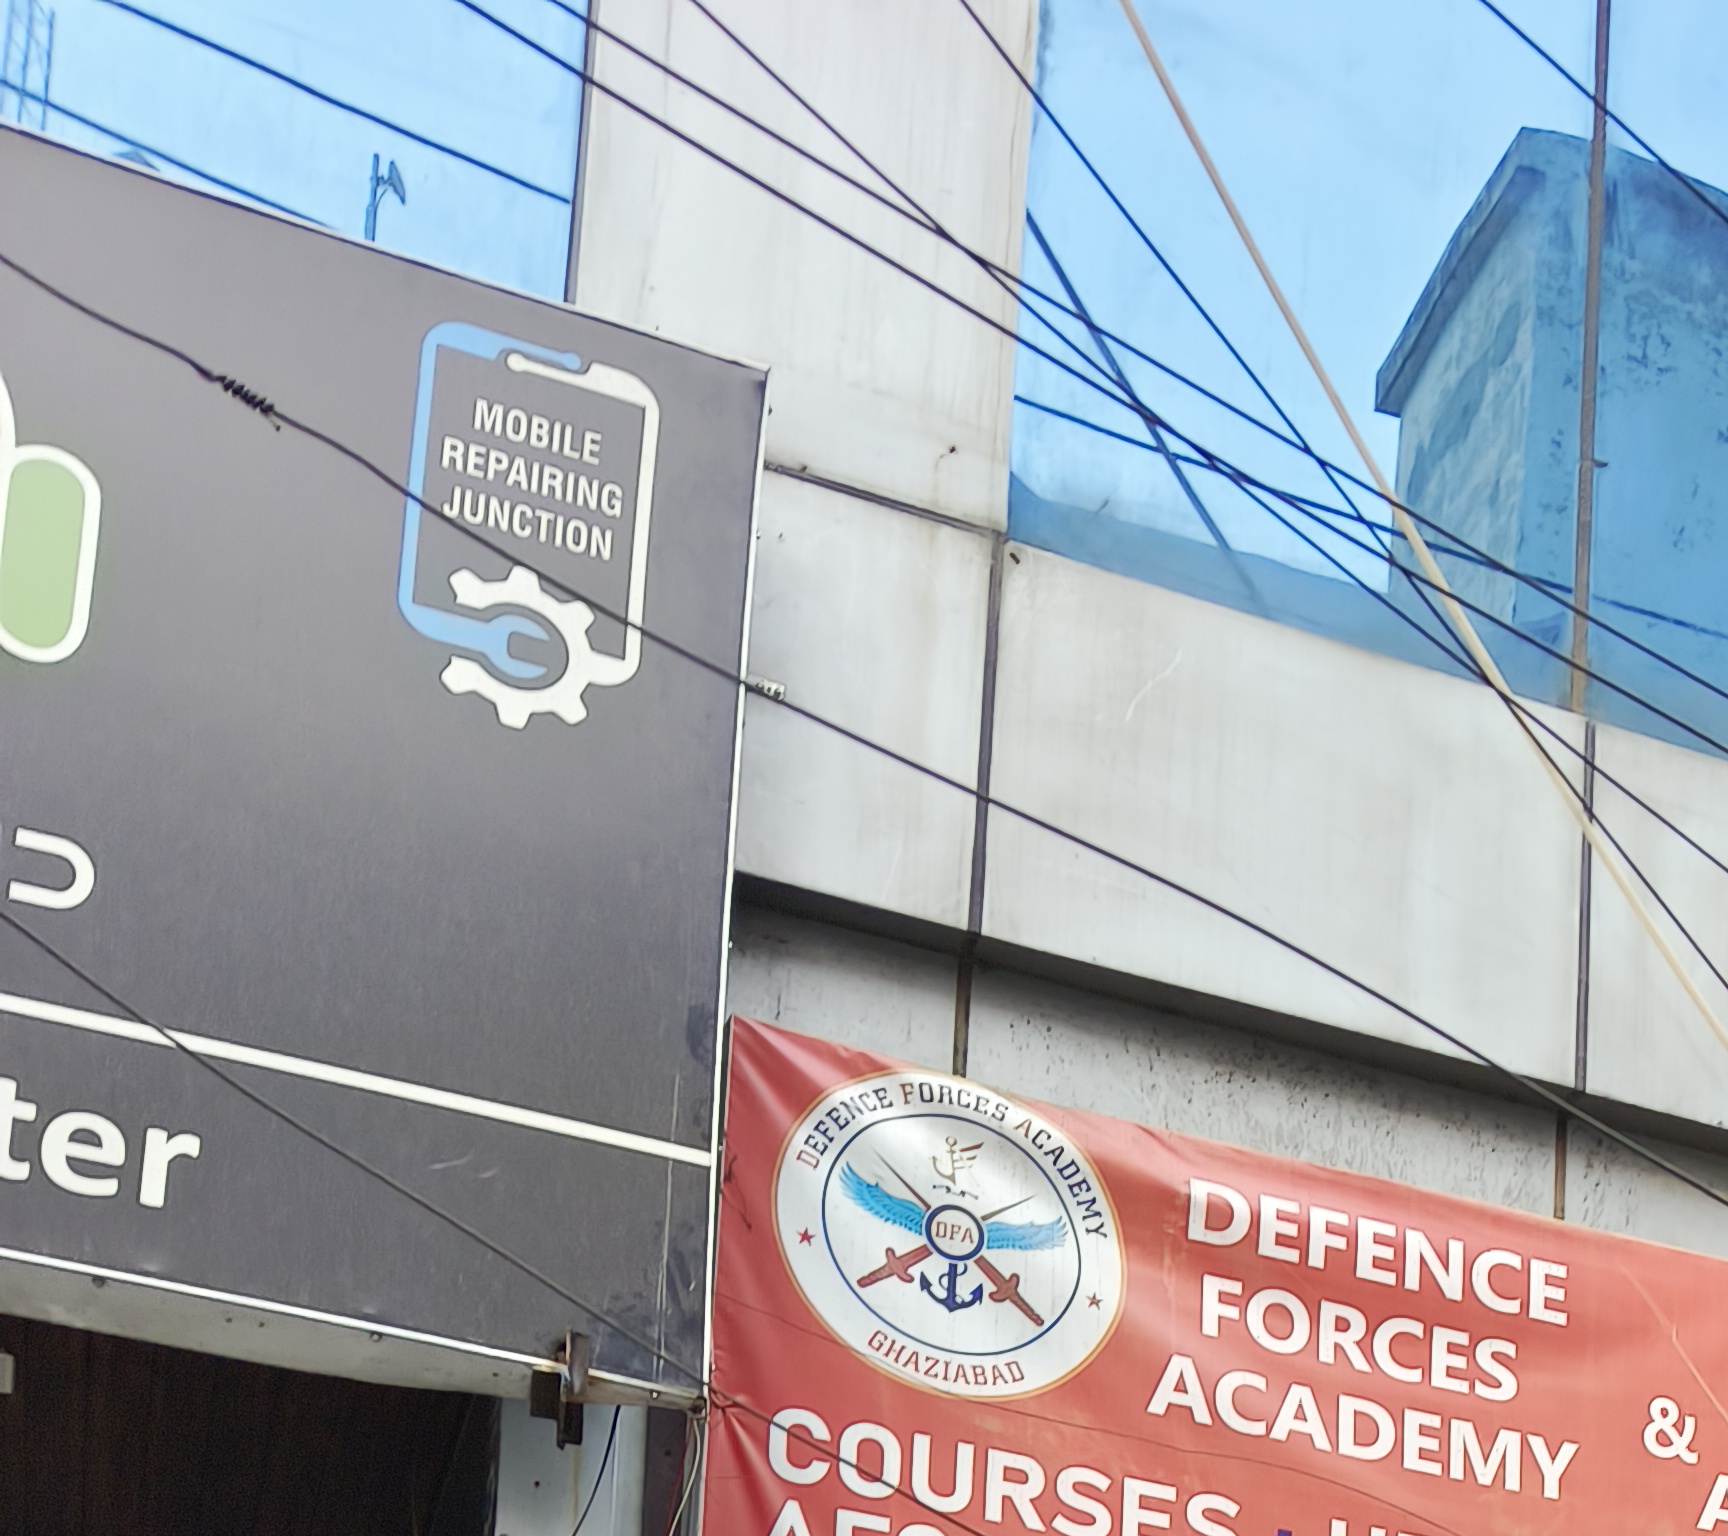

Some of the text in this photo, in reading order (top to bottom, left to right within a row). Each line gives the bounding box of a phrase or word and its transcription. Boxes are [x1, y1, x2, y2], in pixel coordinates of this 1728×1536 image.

[473, 398, 602, 465] MOBILE
[441, 435, 623, 518] REPAIRING
[442, 486, 613, 560] JUNCTION
[796, 1082, 1108, 1239] DEFENCE FORCES ACADEMY
[1187, 1177, 1568, 1326] DEFENCE
[867, 1329, 1025, 1386] GHAZIABAD
[1201, 1274, 1519, 1402] FORCES
[1147, 1354, 1579, 1500] ACADEMY
[1643, 1397, 1699, 1464] &
